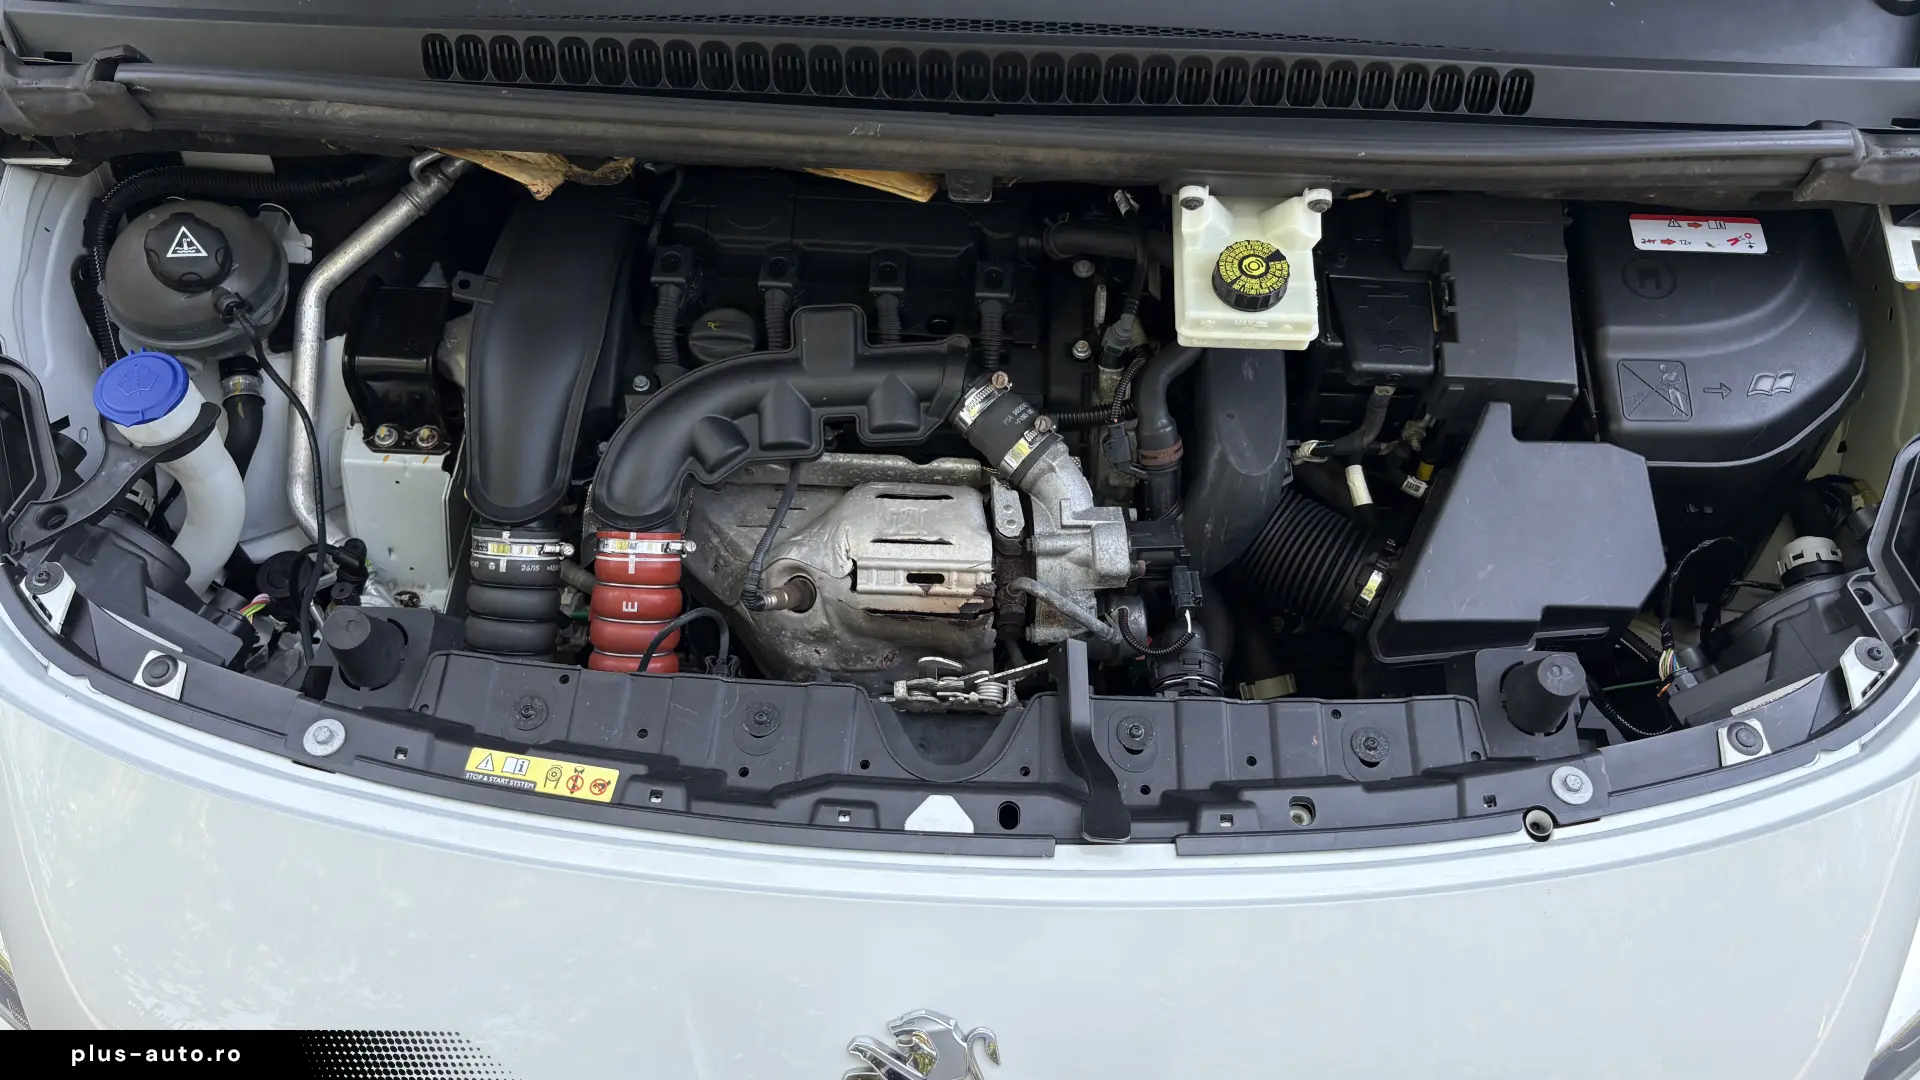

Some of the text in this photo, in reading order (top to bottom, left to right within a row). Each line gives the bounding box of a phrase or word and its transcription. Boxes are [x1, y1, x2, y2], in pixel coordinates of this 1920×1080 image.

[465, 772, 483, 780] STOP
[489, 776, 509, 785] START
[509, 779, 535, 789] SYSTEM
